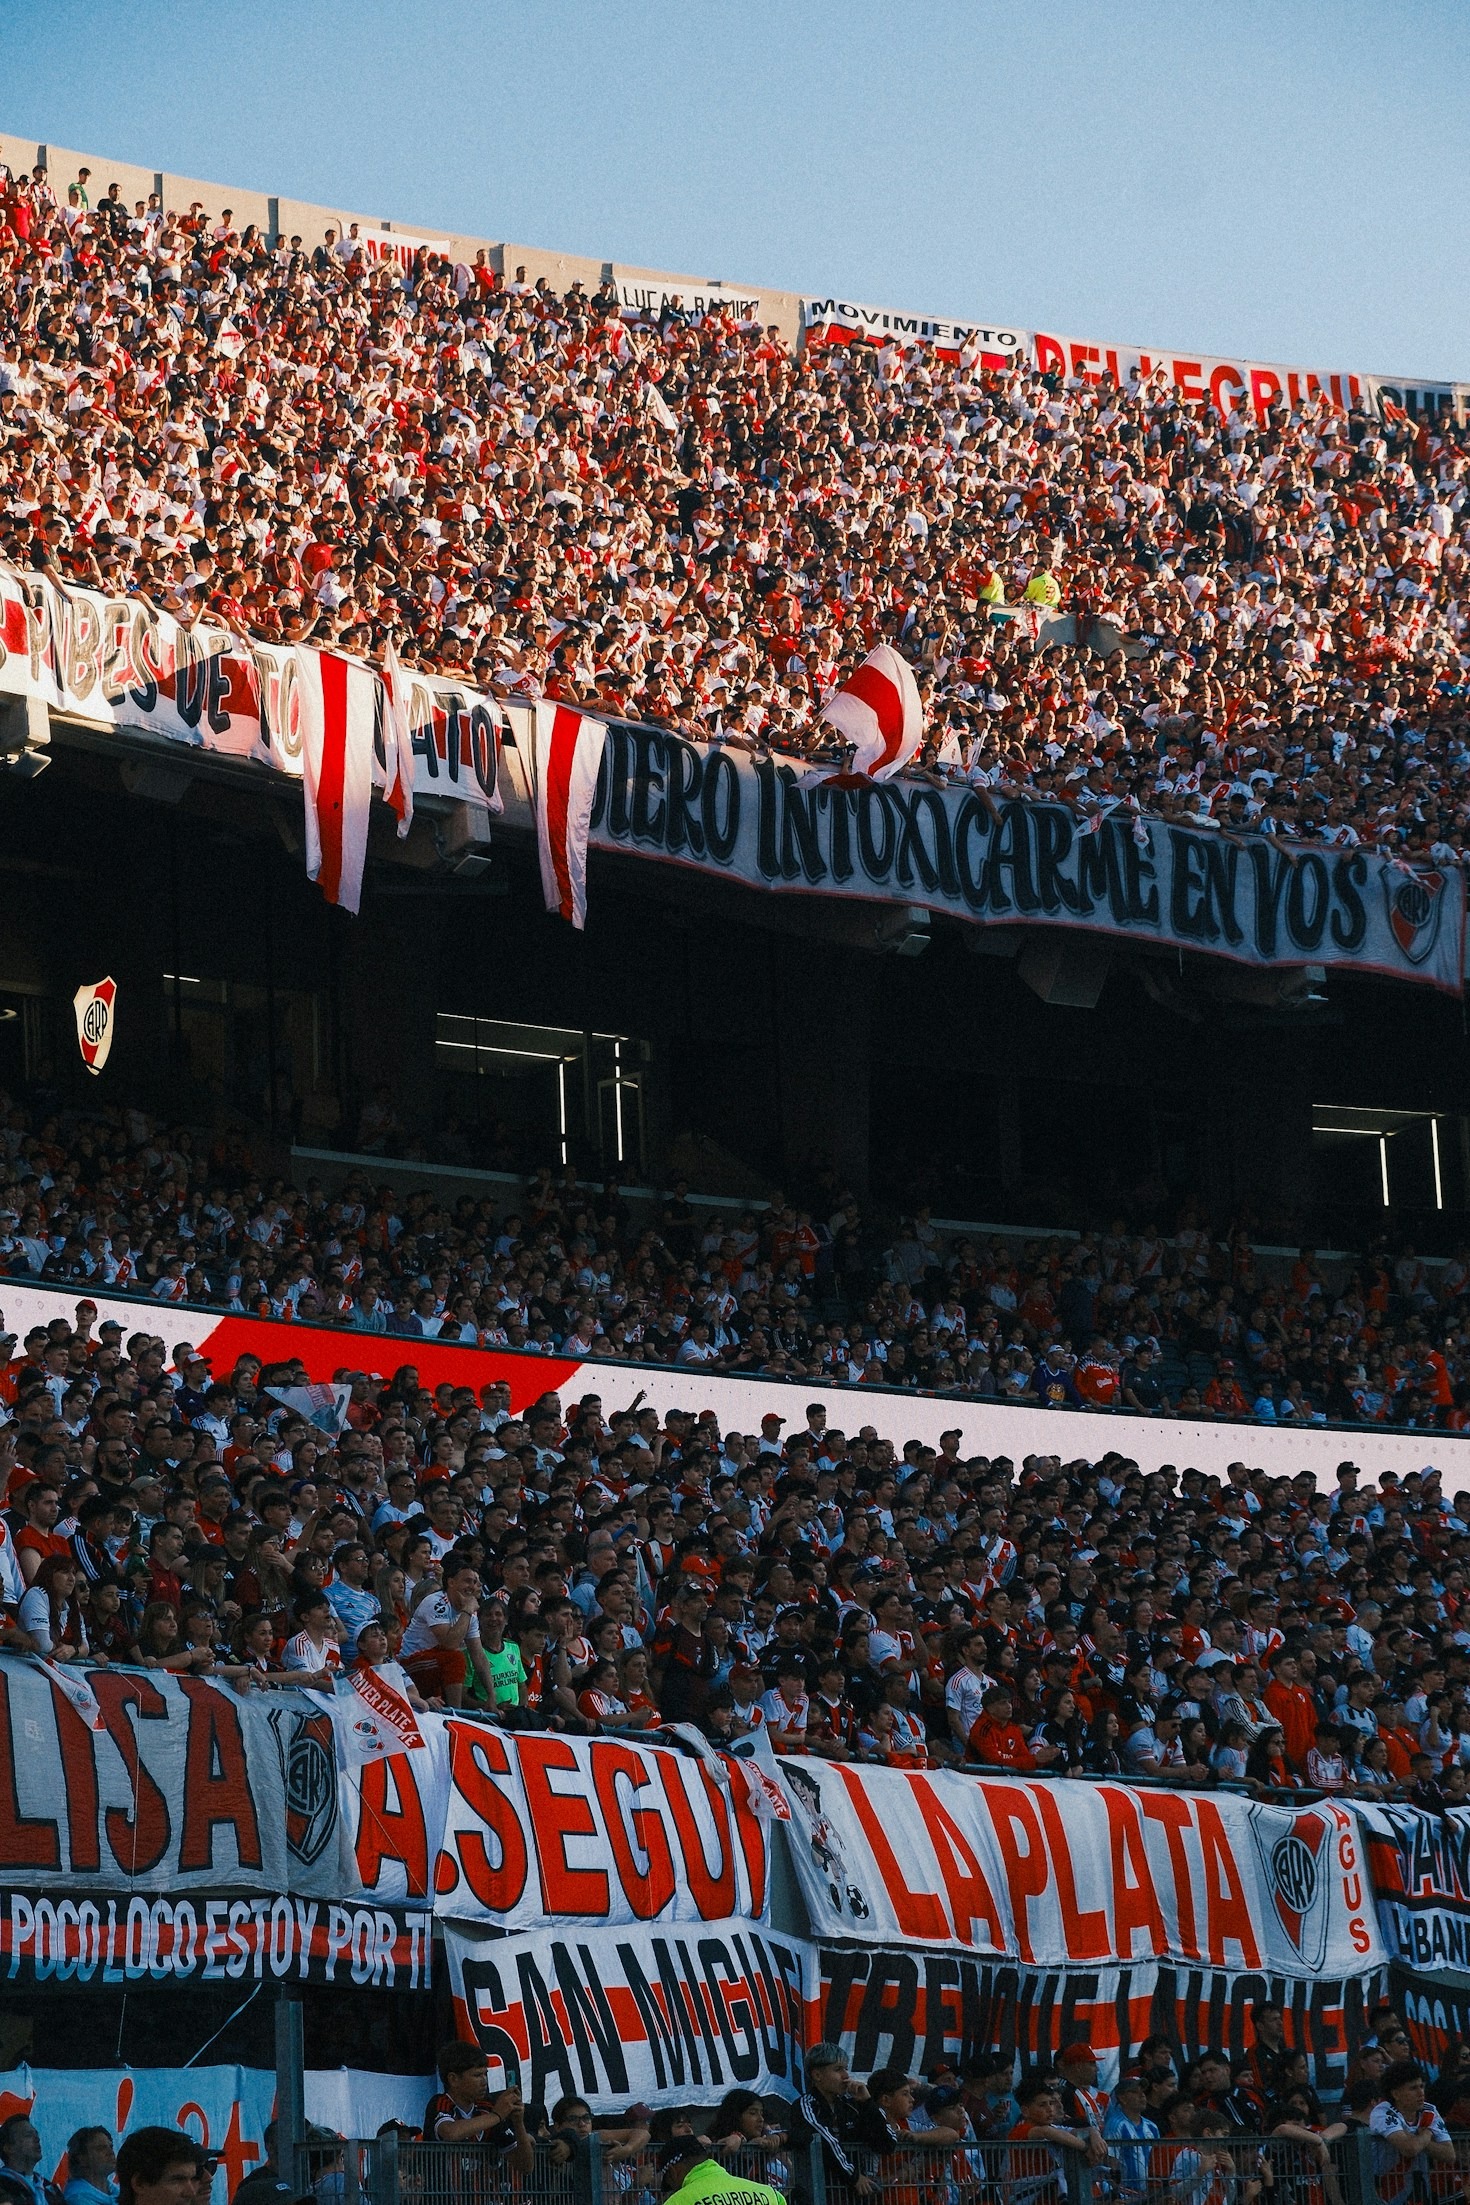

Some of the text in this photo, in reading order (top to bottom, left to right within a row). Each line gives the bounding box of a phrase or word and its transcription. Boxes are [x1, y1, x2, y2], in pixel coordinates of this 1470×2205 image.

[623, 286, 692, 321] LUCA
[811, 299, 1018, 346] MOVIMIENTO
[176, 627, 235, 736] DE
[753, 757, 1161, 928] INTOXICARME
[1170, 828, 1244, 948] EN
[1251, 845, 1367, 958] VOS
[351, 1672, 412, 1730] RIVER PLATE
[1325, 1803, 1370, 1955] AGUS
[7, 1893, 101, 1981] POCO
[102, 1895, 199, 1983] LOCO
[201, 1893, 319, 1980] ESTOY
[325, 1905, 397, 1988] POR
[462, 1930, 807, 2108] SAN MIGUEL
[694, 2191, 770, 2205] EGURIDAD
